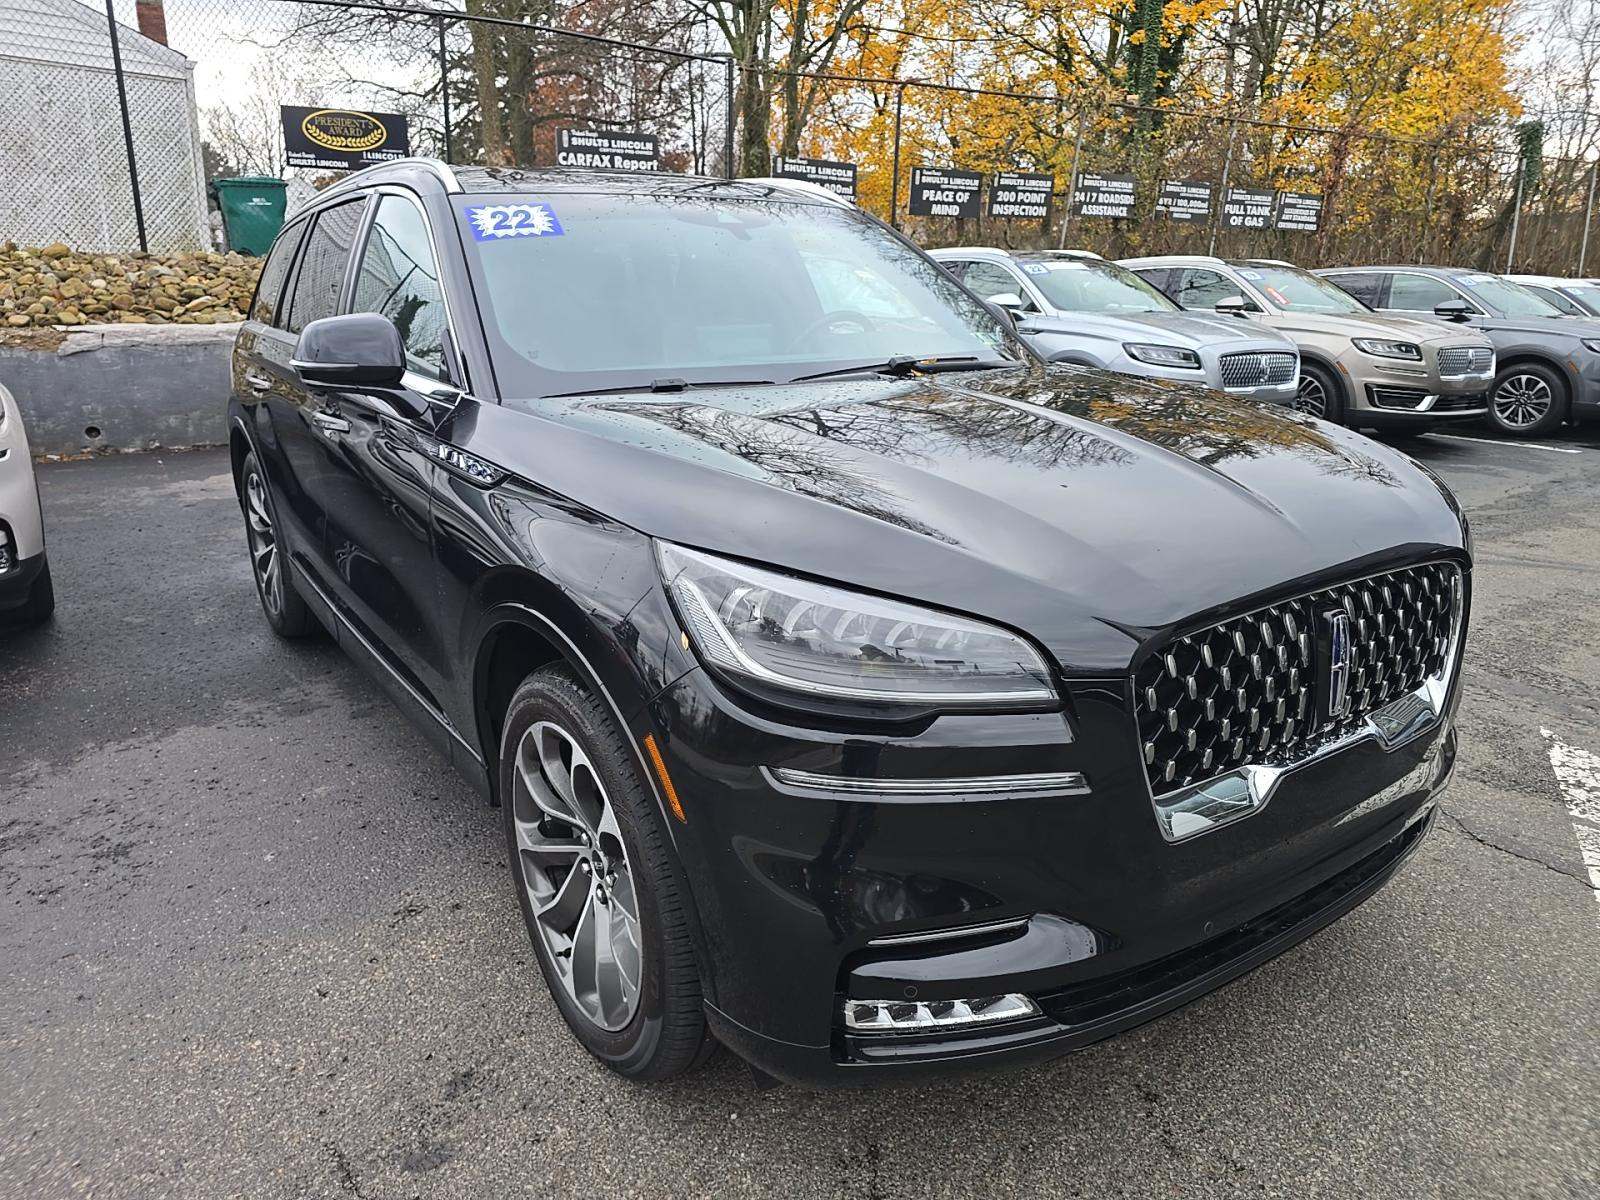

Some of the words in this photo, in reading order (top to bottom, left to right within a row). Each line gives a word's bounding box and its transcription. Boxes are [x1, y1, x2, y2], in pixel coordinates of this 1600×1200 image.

[314, 116, 374, 129] PRESIDENT'S
[328, 125, 363, 137] AWARD
[571, 137, 609, 148] SHULTS
[611, 140, 653, 151] LINCOLN
[289, 158, 316, 167] SHULTS
[317, 159, 349, 168] LINCOLN
[558, 152, 611, 168] CARFAX
[613, 155, 659, 171] Report
[784, 163, 817, 174] SHULTS
[818, 166, 853, 178] LINCOLN
[922, 189, 955, 202] PEACE
[955, 191, 970, 203] OF
[996, 190, 1016, 202] 200
[1017, 191, 1046, 204] POINT
[1098, 192, 1135, 205] ROADSIDE
[931, 203, 960, 216] MIND
[992, 203, 1047, 217] INSPECTION
[1081, 204, 1128, 217] ASSISTANCE
[1224, 203, 1245, 215] FULL
[1246, 205, 1271, 217] TANK
[491, 209, 535, 231] 22
[1229, 215, 1244, 226] OF
[1244, 216, 1264, 227] GAS
